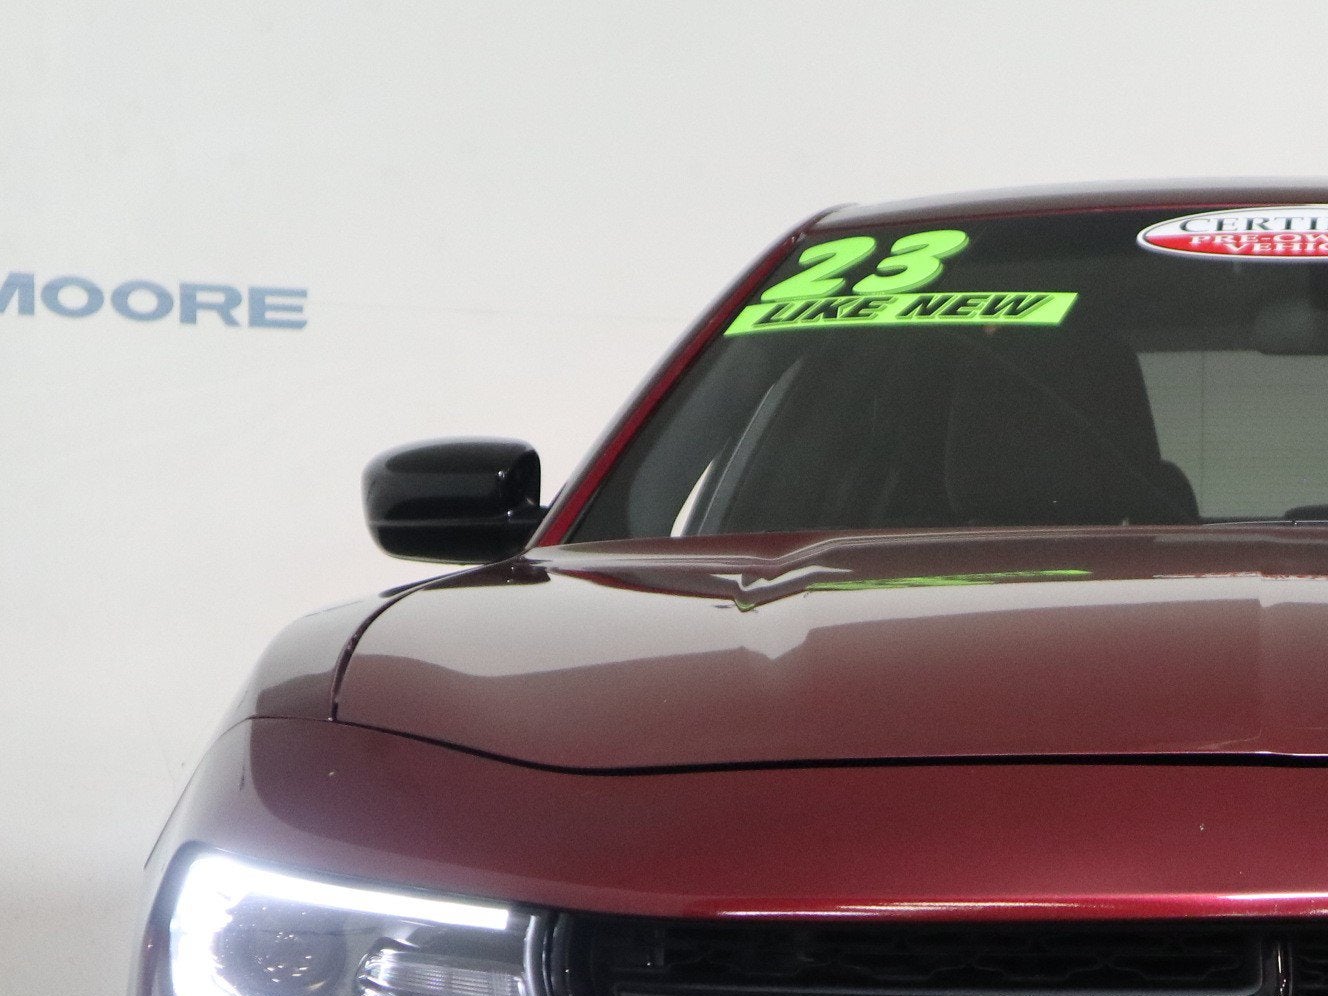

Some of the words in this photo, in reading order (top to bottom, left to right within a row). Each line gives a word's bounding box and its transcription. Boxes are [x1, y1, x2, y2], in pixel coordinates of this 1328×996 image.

[760, 229, 970, 303] 23
[752, 296, 897, 327] LIKE
[896, 294, 1055, 319] NEW
